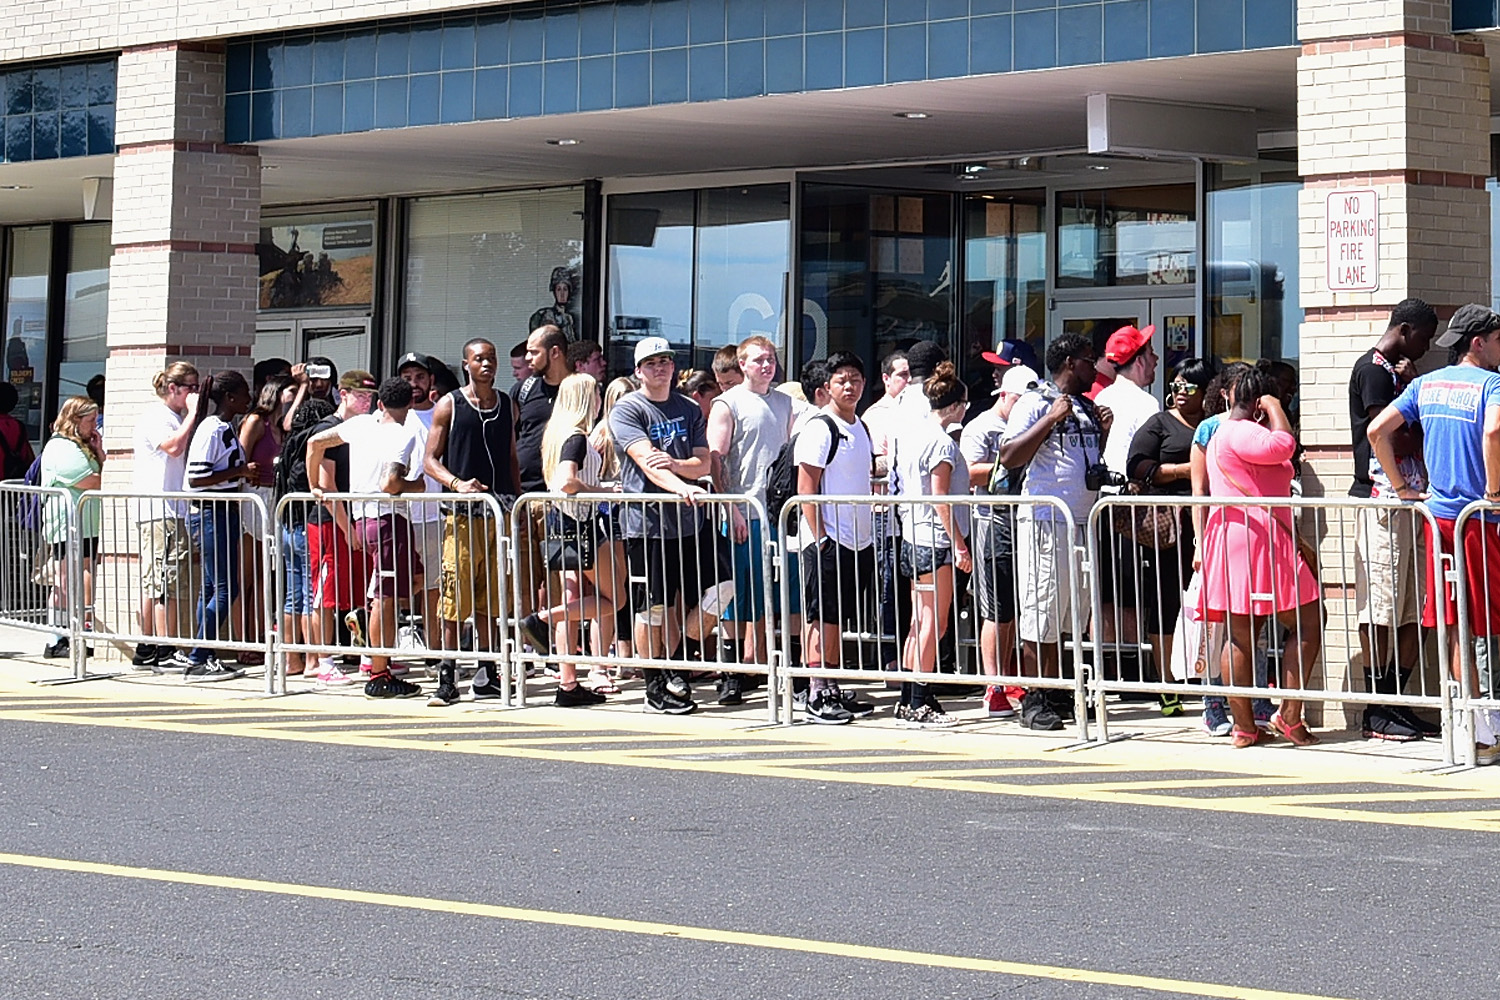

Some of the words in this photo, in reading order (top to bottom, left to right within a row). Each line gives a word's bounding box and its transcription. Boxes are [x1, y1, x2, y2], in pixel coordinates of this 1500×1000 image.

[1344, 196, 1360, 214] NO
[1330, 219, 1374, 238] PARKING
[1340, 242, 1364, 260] FIRE
[1338, 266, 1366, 284] LANE
